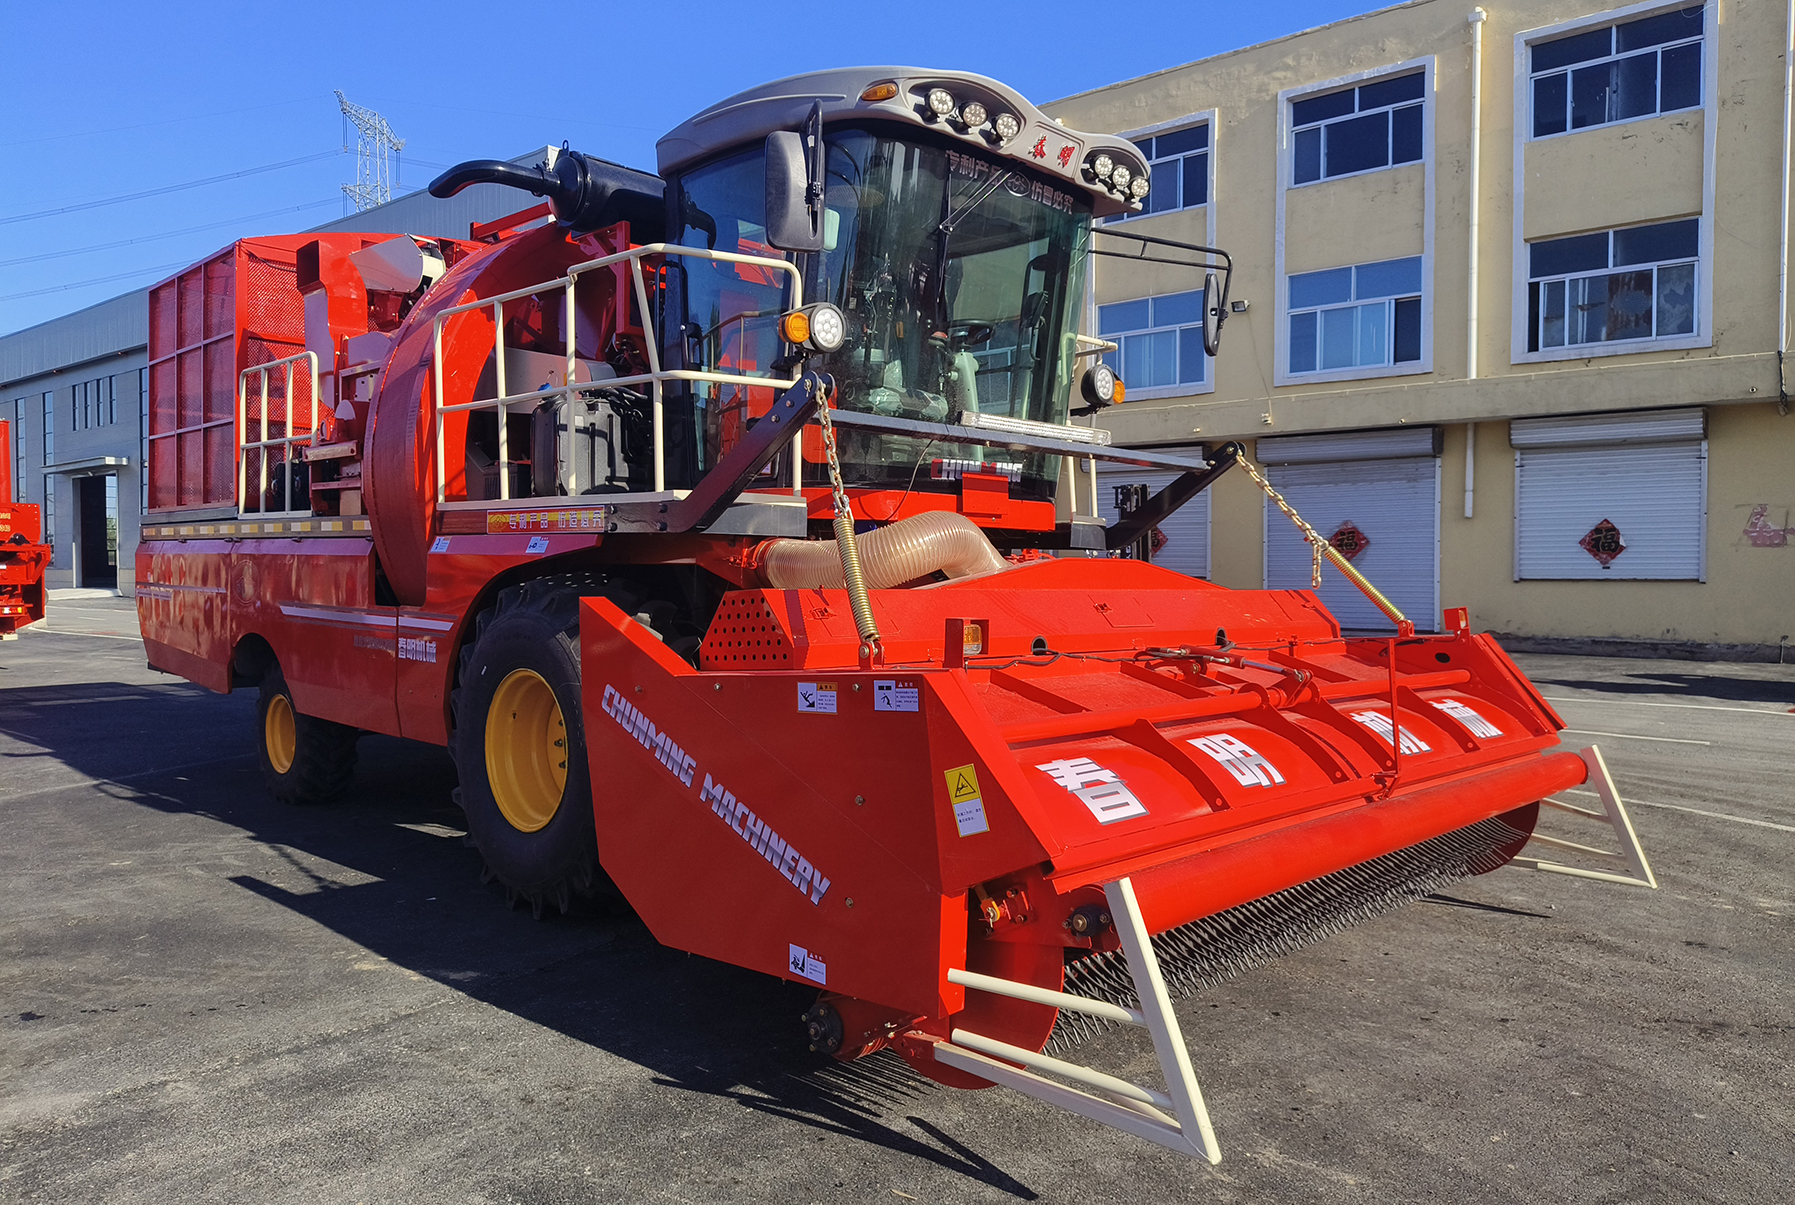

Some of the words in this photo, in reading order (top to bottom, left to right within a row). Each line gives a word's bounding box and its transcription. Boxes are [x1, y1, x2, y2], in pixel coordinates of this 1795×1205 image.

[1031, 180, 1074, 215] 仿冒必究
[509, 511, 549, 530] 专利产品
[558, 510, 602, 528] 仿造必究
[1336, 530, 1359, 551] 福
[1591, 528, 1620, 553] 福
[398, 637, 437, 664] 春明机械
[1035, 698, 1504, 826] 春明机械
[601, 683, 697, 788] CHUNMING
[700, 772, 831, 907] MACHINERY
